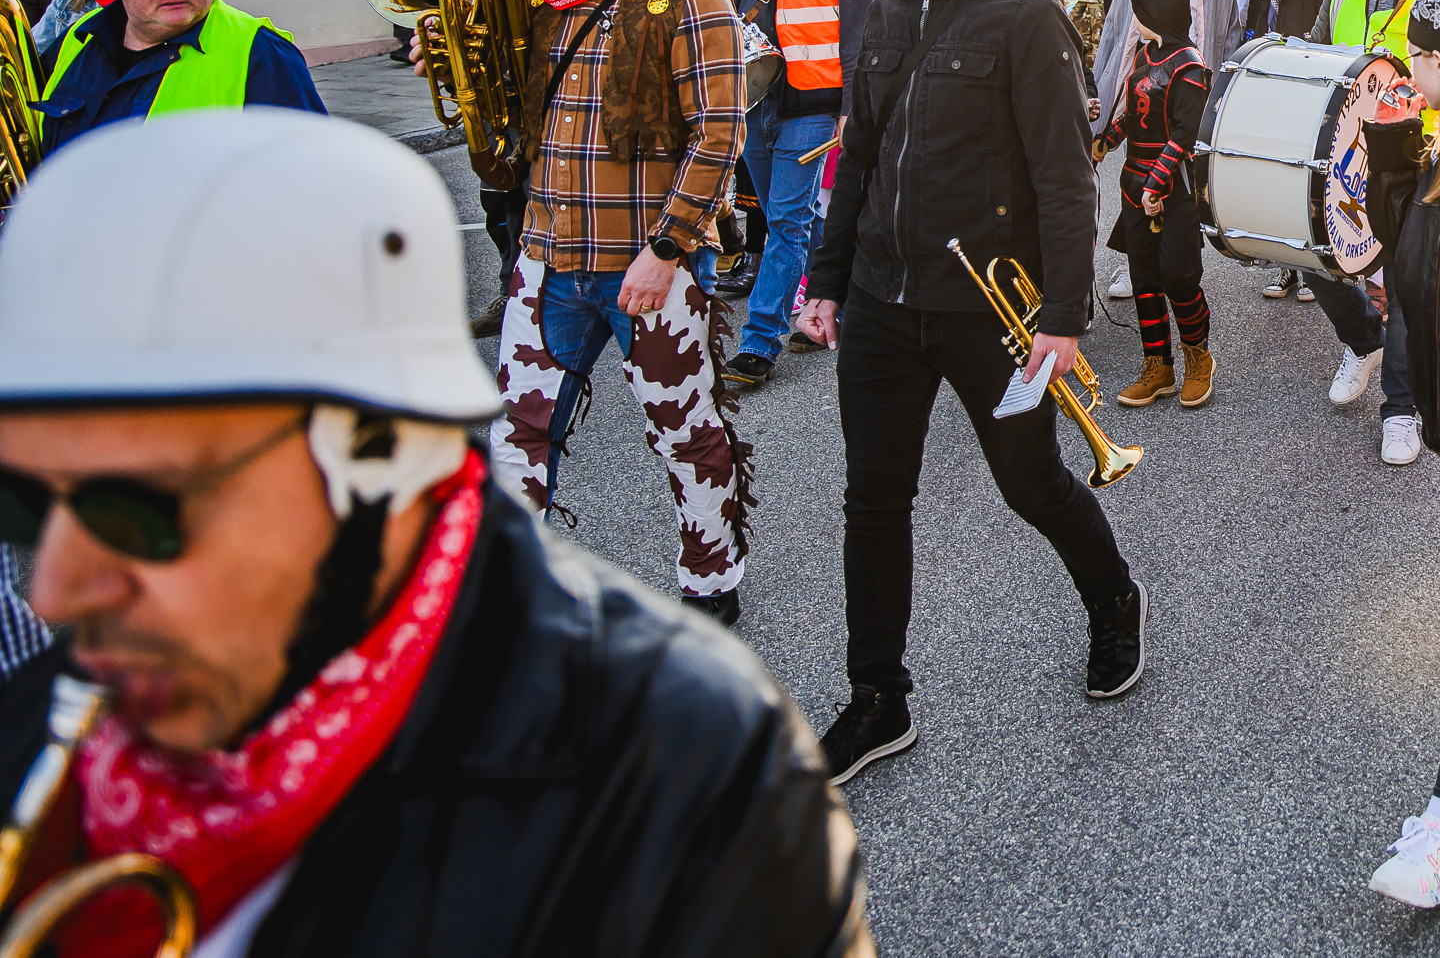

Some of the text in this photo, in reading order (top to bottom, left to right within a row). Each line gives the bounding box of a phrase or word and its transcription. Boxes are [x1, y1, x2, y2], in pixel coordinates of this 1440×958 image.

[1340, 82, 1361, 119] 1920
[1325, 203, 1345, 253] PIHALNI
[1345, 235, 1377, 259] ORKESTE
